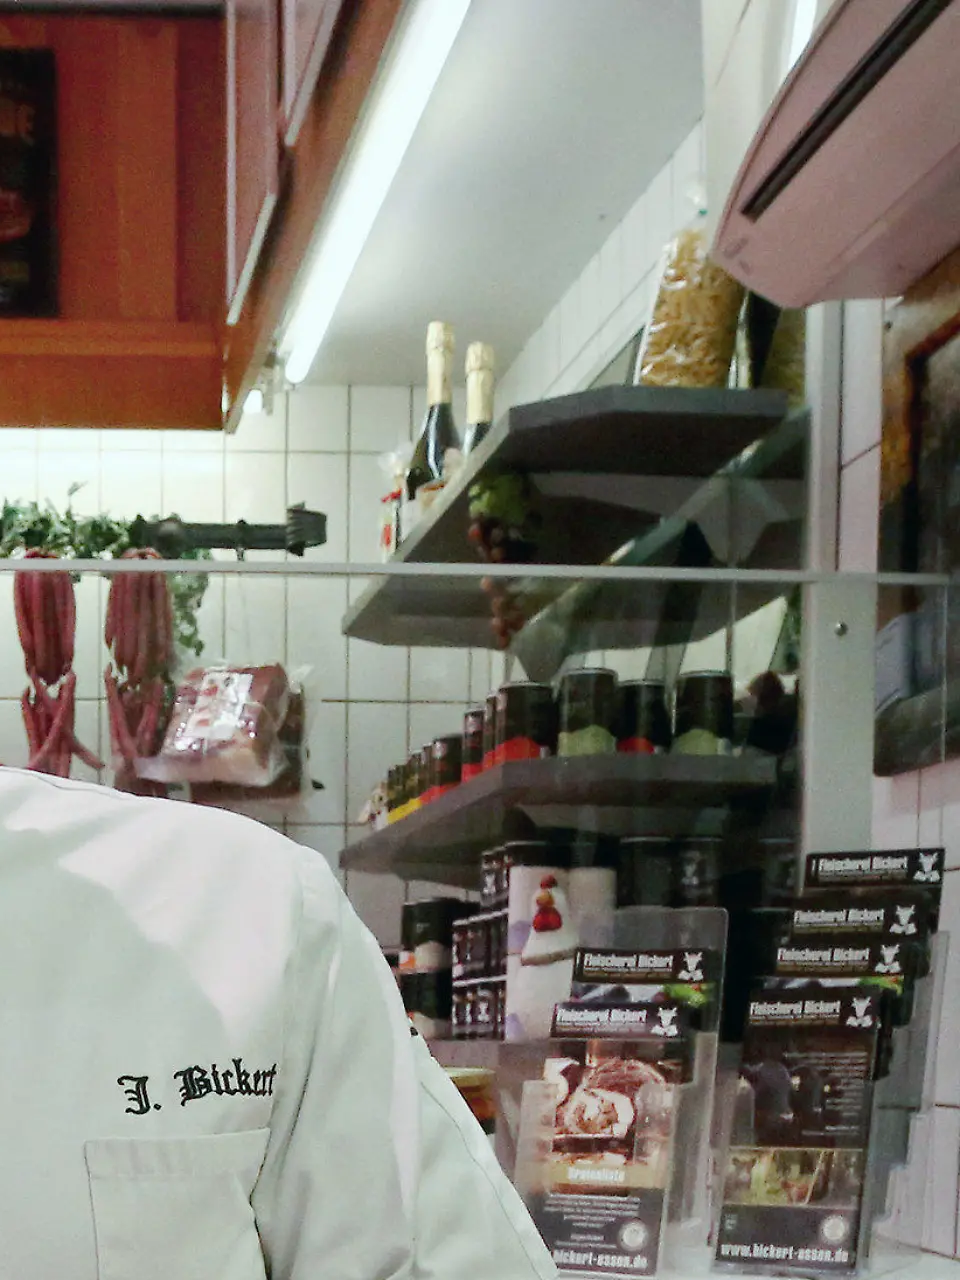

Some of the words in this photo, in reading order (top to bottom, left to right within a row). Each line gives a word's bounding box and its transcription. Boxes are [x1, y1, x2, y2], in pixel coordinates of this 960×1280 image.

[117, 1075, 162, 1115] J.
[173, 1058, 278, 1107] Bickert
[552, 1248, 649, 1269] bickert-essen.de
[720, 1243, 849, 1263] www.bickert-essen.de
